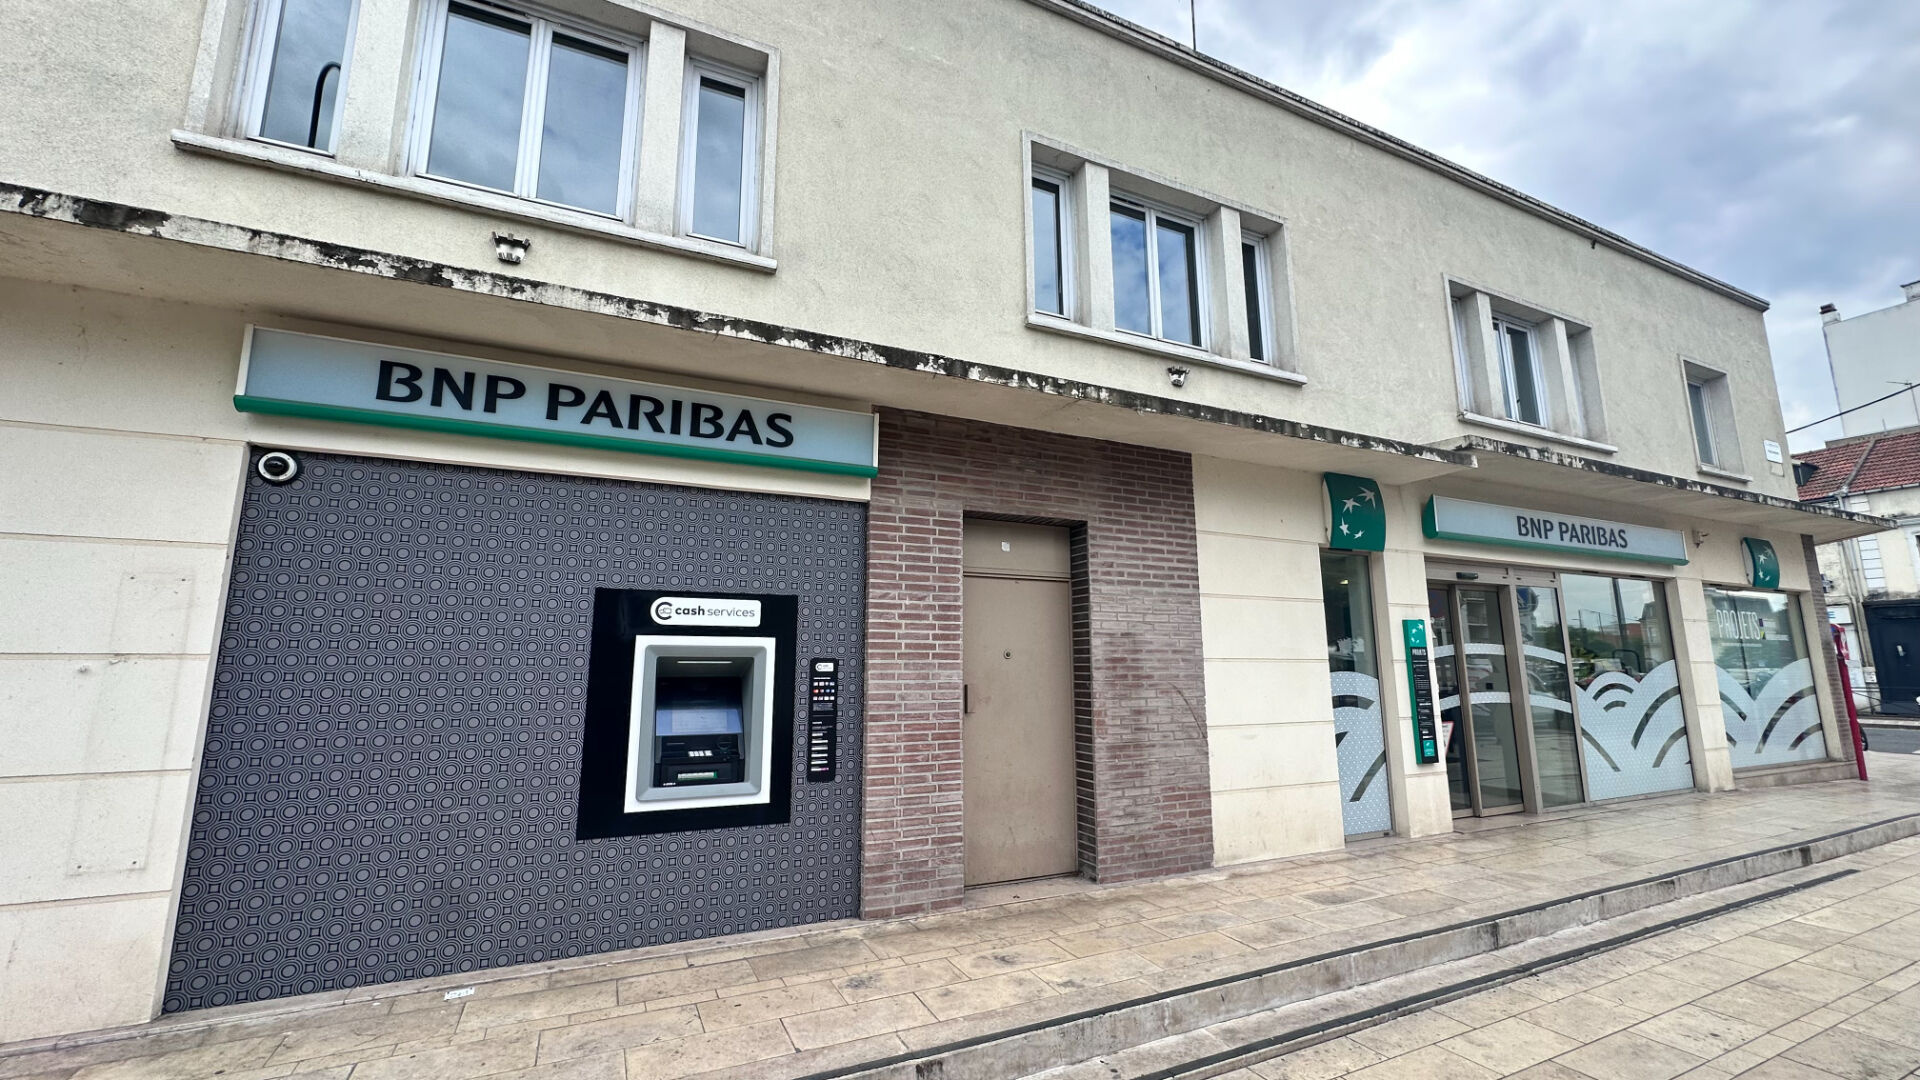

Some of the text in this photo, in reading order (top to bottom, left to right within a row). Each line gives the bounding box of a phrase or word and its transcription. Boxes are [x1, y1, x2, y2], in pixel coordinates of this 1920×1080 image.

[376, 360, 794, 448] BNP PARIBAS
[1516, 515, 1628, 549] BNP PARIBAS
[675, 605, 755, 617] cash services
[1716, 610, 1760, 640] PROJETS
